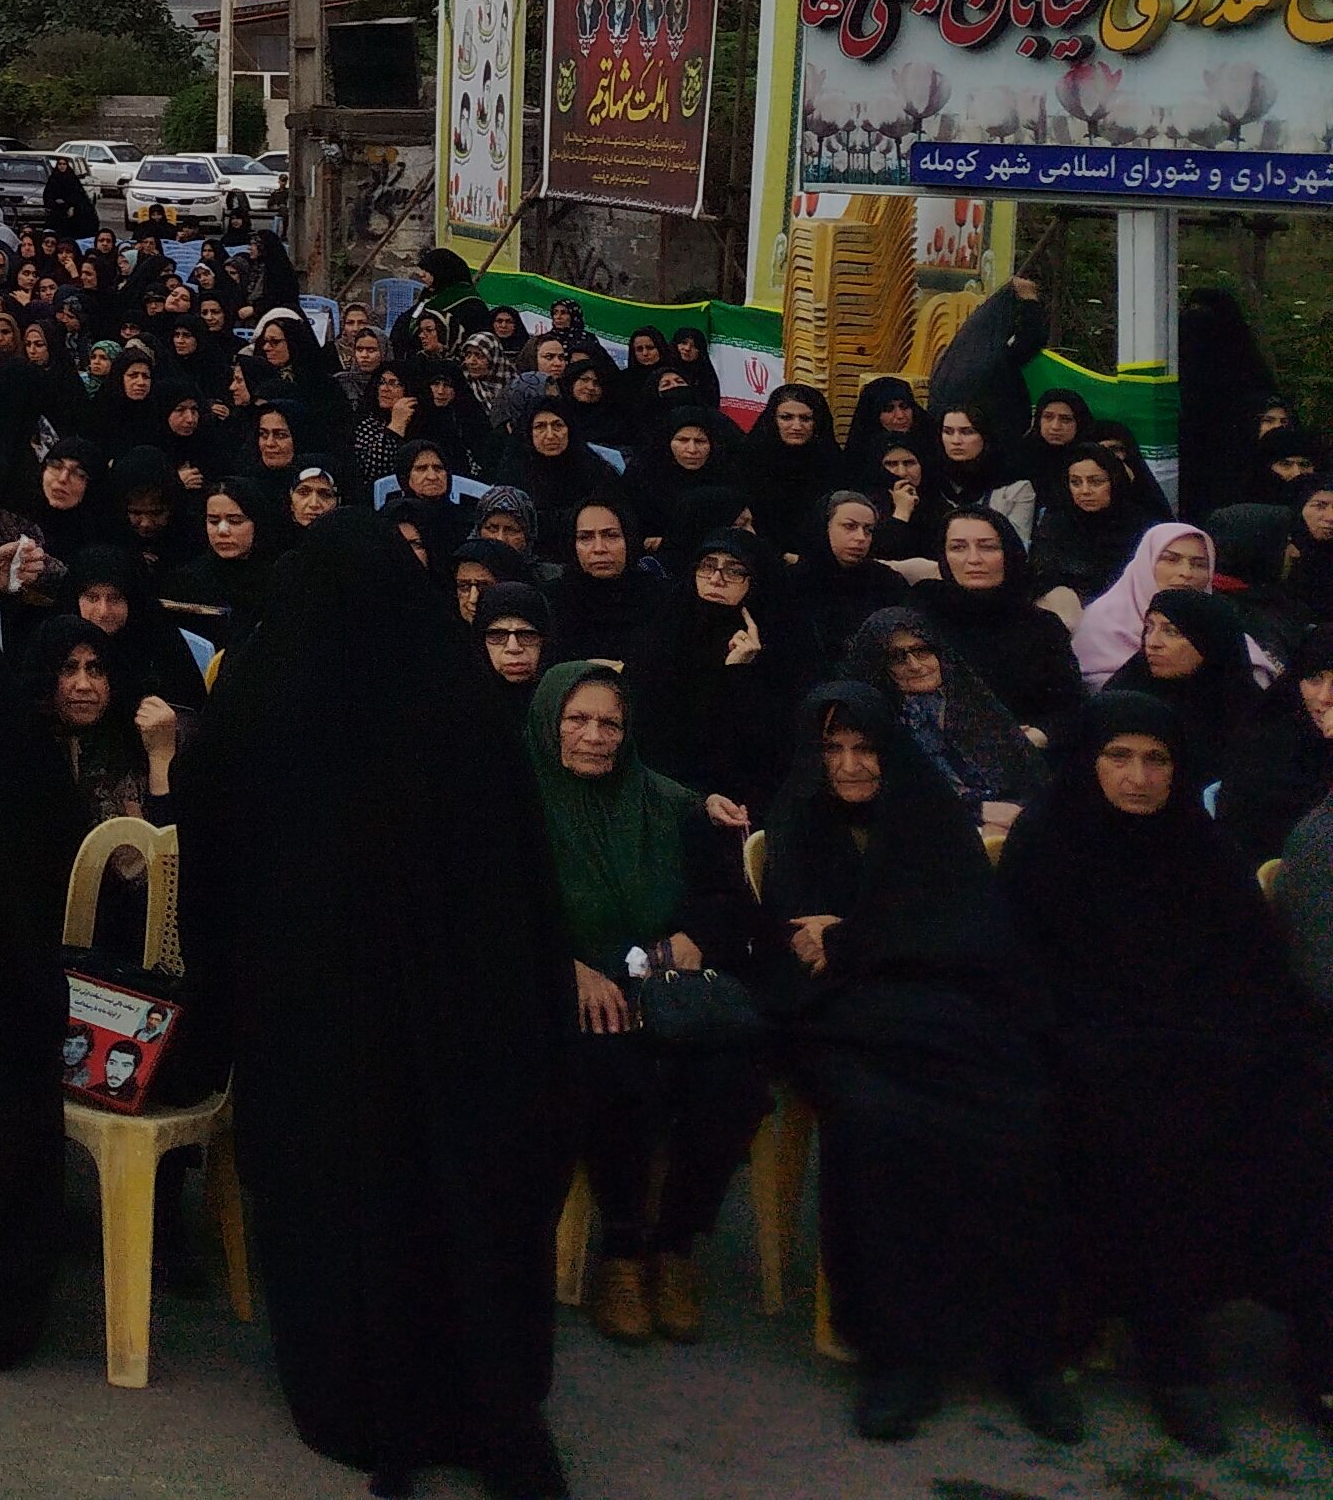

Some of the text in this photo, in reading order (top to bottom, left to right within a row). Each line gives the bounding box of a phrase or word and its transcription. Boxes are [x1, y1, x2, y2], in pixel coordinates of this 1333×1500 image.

[919, 149, 980, 175] کومله
[985, 155, 1031, 182] شهر
[1038, 150, 1116, 185] اسلامی
[1123, 154, 1201, 188] شورای
[1208, 167, 1223, 191] و
